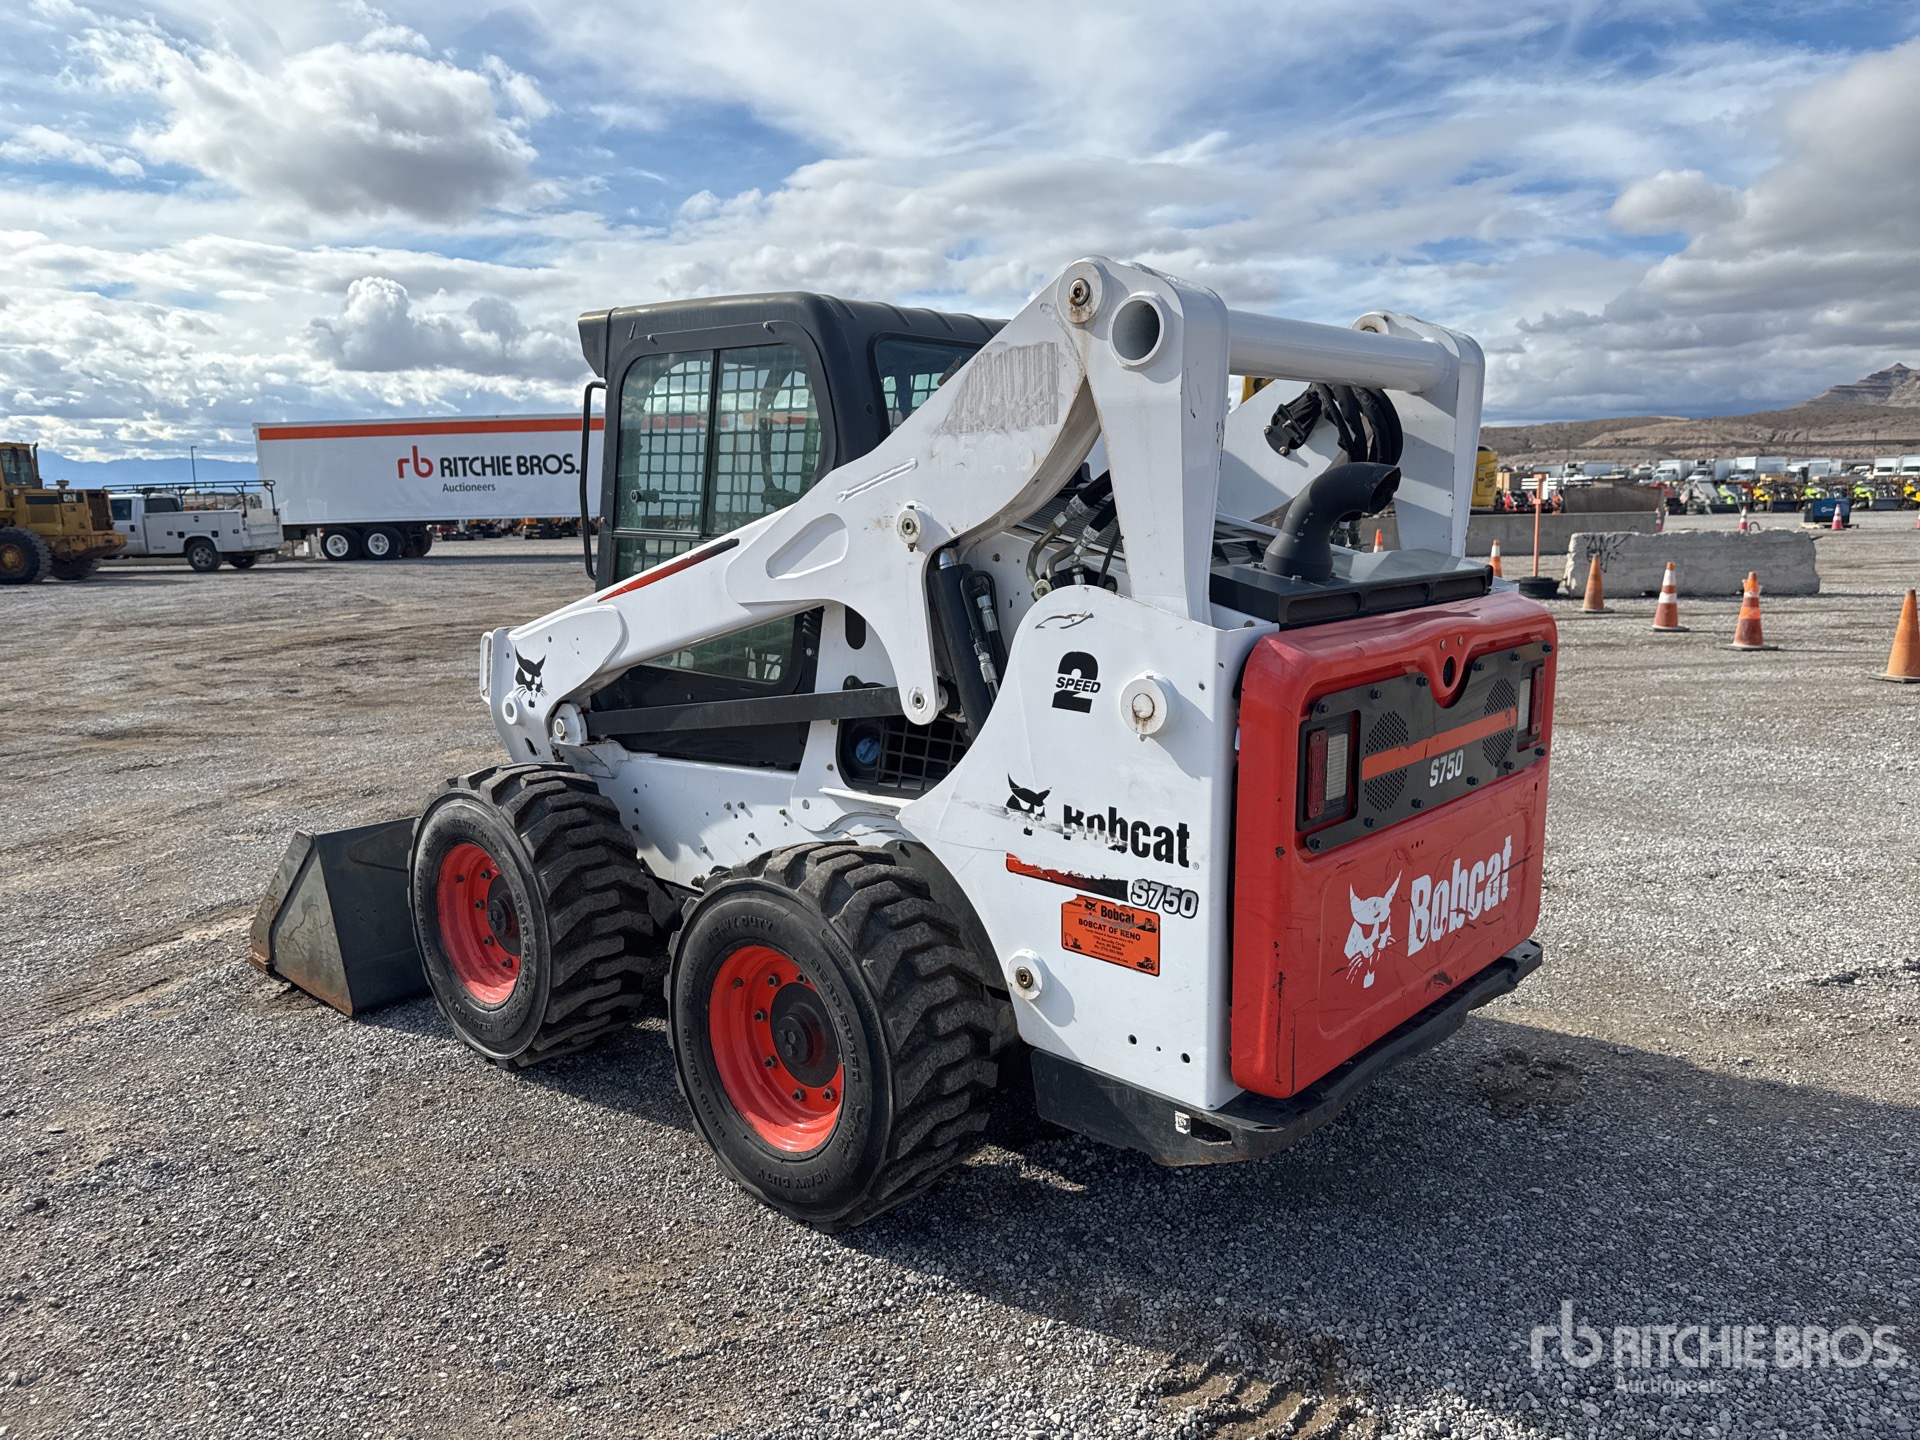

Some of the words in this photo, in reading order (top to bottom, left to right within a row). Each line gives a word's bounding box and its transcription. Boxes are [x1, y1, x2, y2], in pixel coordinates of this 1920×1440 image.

[397, 445, 434, 479] rb
[440, 453, 513, 477] RITCHIE
[517, 453, 581, 476] BROS.
[441, 482, 496, 495] Auctioneers
[1051, 650, 1099, 714] 2
[1055, 675, 1102, 696] SPEED
[1429, 748, 1465, 788] S750
[1063, 803, 1190, 870] Bobcat
[1130, 878, 1199, 920] S750
[1407, 835, 1512, 957] Bobcat
[741, 915, 773, 932] DUTY
[1078, 918, 1107, 932] BOBCAT
[1108, 926, 1118, 934] OF
[1120, 929, 1141, 941] RENO
[1101, 905, 1136, 923] Bobcat
